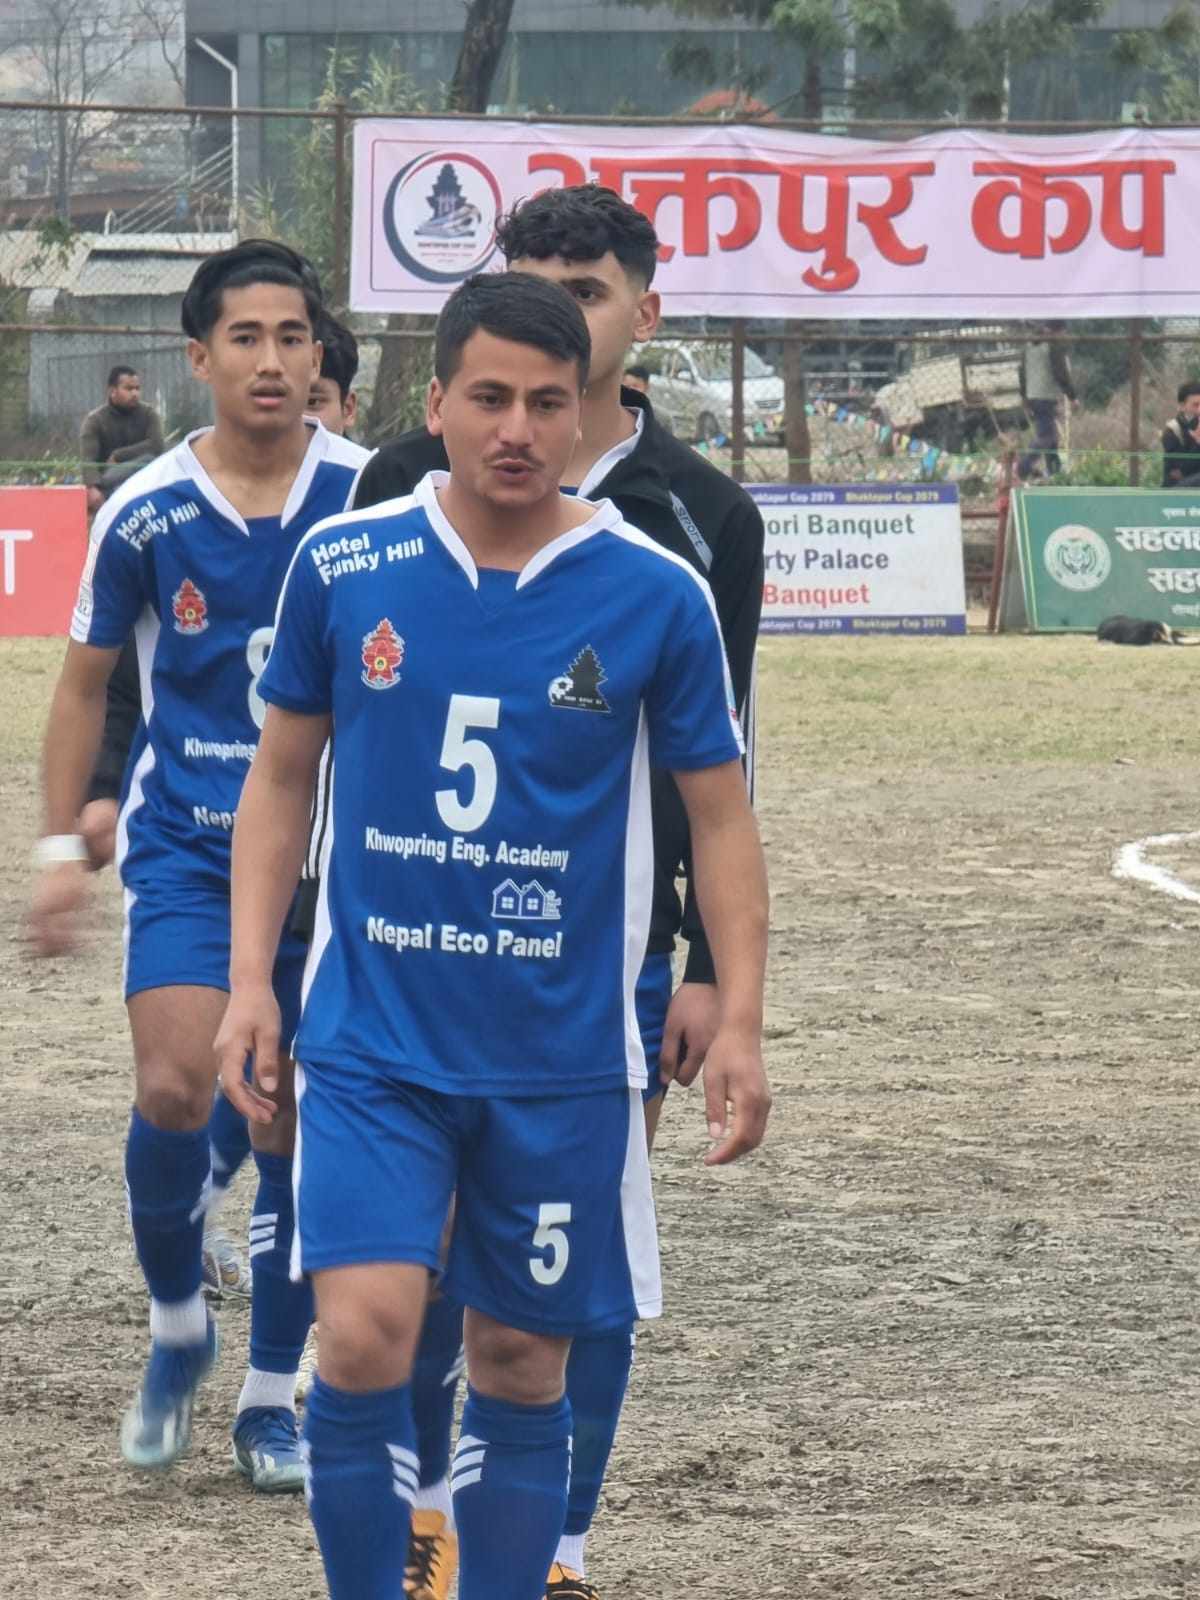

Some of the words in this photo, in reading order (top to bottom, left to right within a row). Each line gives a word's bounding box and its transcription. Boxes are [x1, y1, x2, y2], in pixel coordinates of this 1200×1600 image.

[971, 159, 1176, 260] कप
[115, 500, 157, 541] Hotel
[169, 501, 201, 525] Hill
[765, 514, 798, 536] ori
[807, 514, 915, 539] Banquet
[310, 532, 370, 566] Hotel
[318, 551, 379, 585] Funky
[386, 537, 424, 562] Hill
[764, 549, 796, 575] rty
[804, 549, 889, 570] Palace
[763, 584, 871, 609] Banquet
[435, 694, 500, 832] 5
[193, 806, 236, 831] Nep
[365, 826, 447, 864] Khwopring
[451, 836, 490, 867] Eng.
[495, 840, 569, 873] Academy
[366, 916, 433, 953] Nepal
[440, 924, 489, 954] Eco
[496, 928, 563, 959] Panel
[529, 1203, 571, 1286] 5
